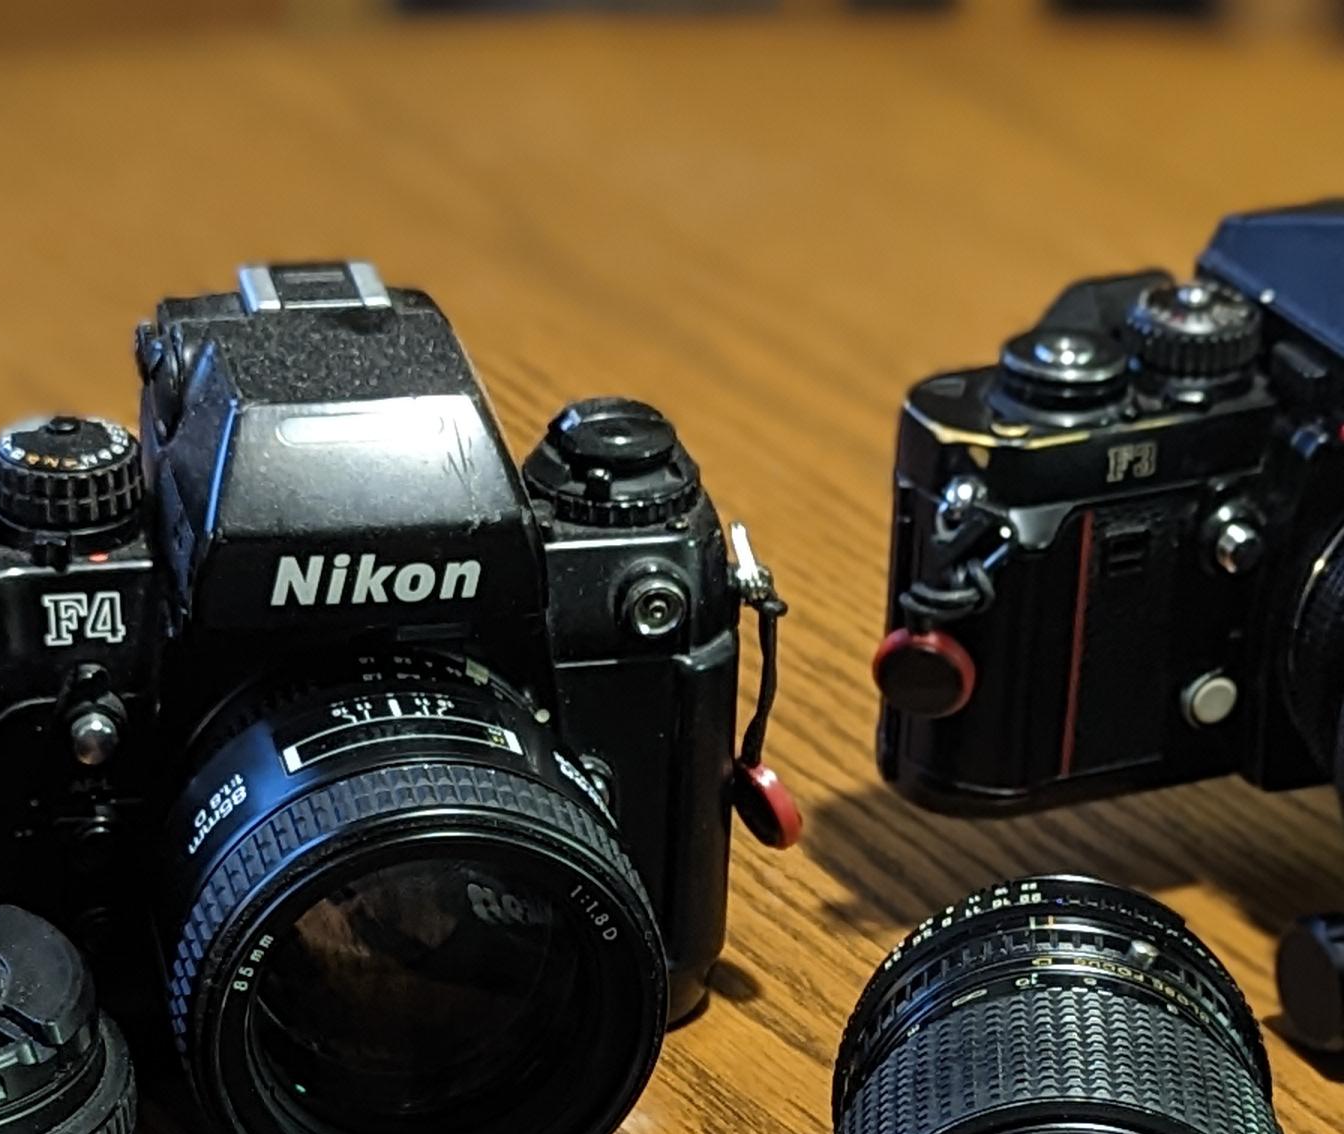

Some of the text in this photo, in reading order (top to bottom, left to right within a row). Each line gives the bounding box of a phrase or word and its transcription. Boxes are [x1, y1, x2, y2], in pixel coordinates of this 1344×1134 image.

[1106, 442, 1157, 483] F3
[270, 554, 482, 607] Nikon
[41, 591, 126, 646] F4
[188, 785, 247, 854] 85mm
[194, 773, 244, 828] 1:1.8 D
[570, 885, 617, 940] 1:1.8 D
[233, 934, 274, 991] 85mm
[1074, 957, 1144, 983] FOCUS
